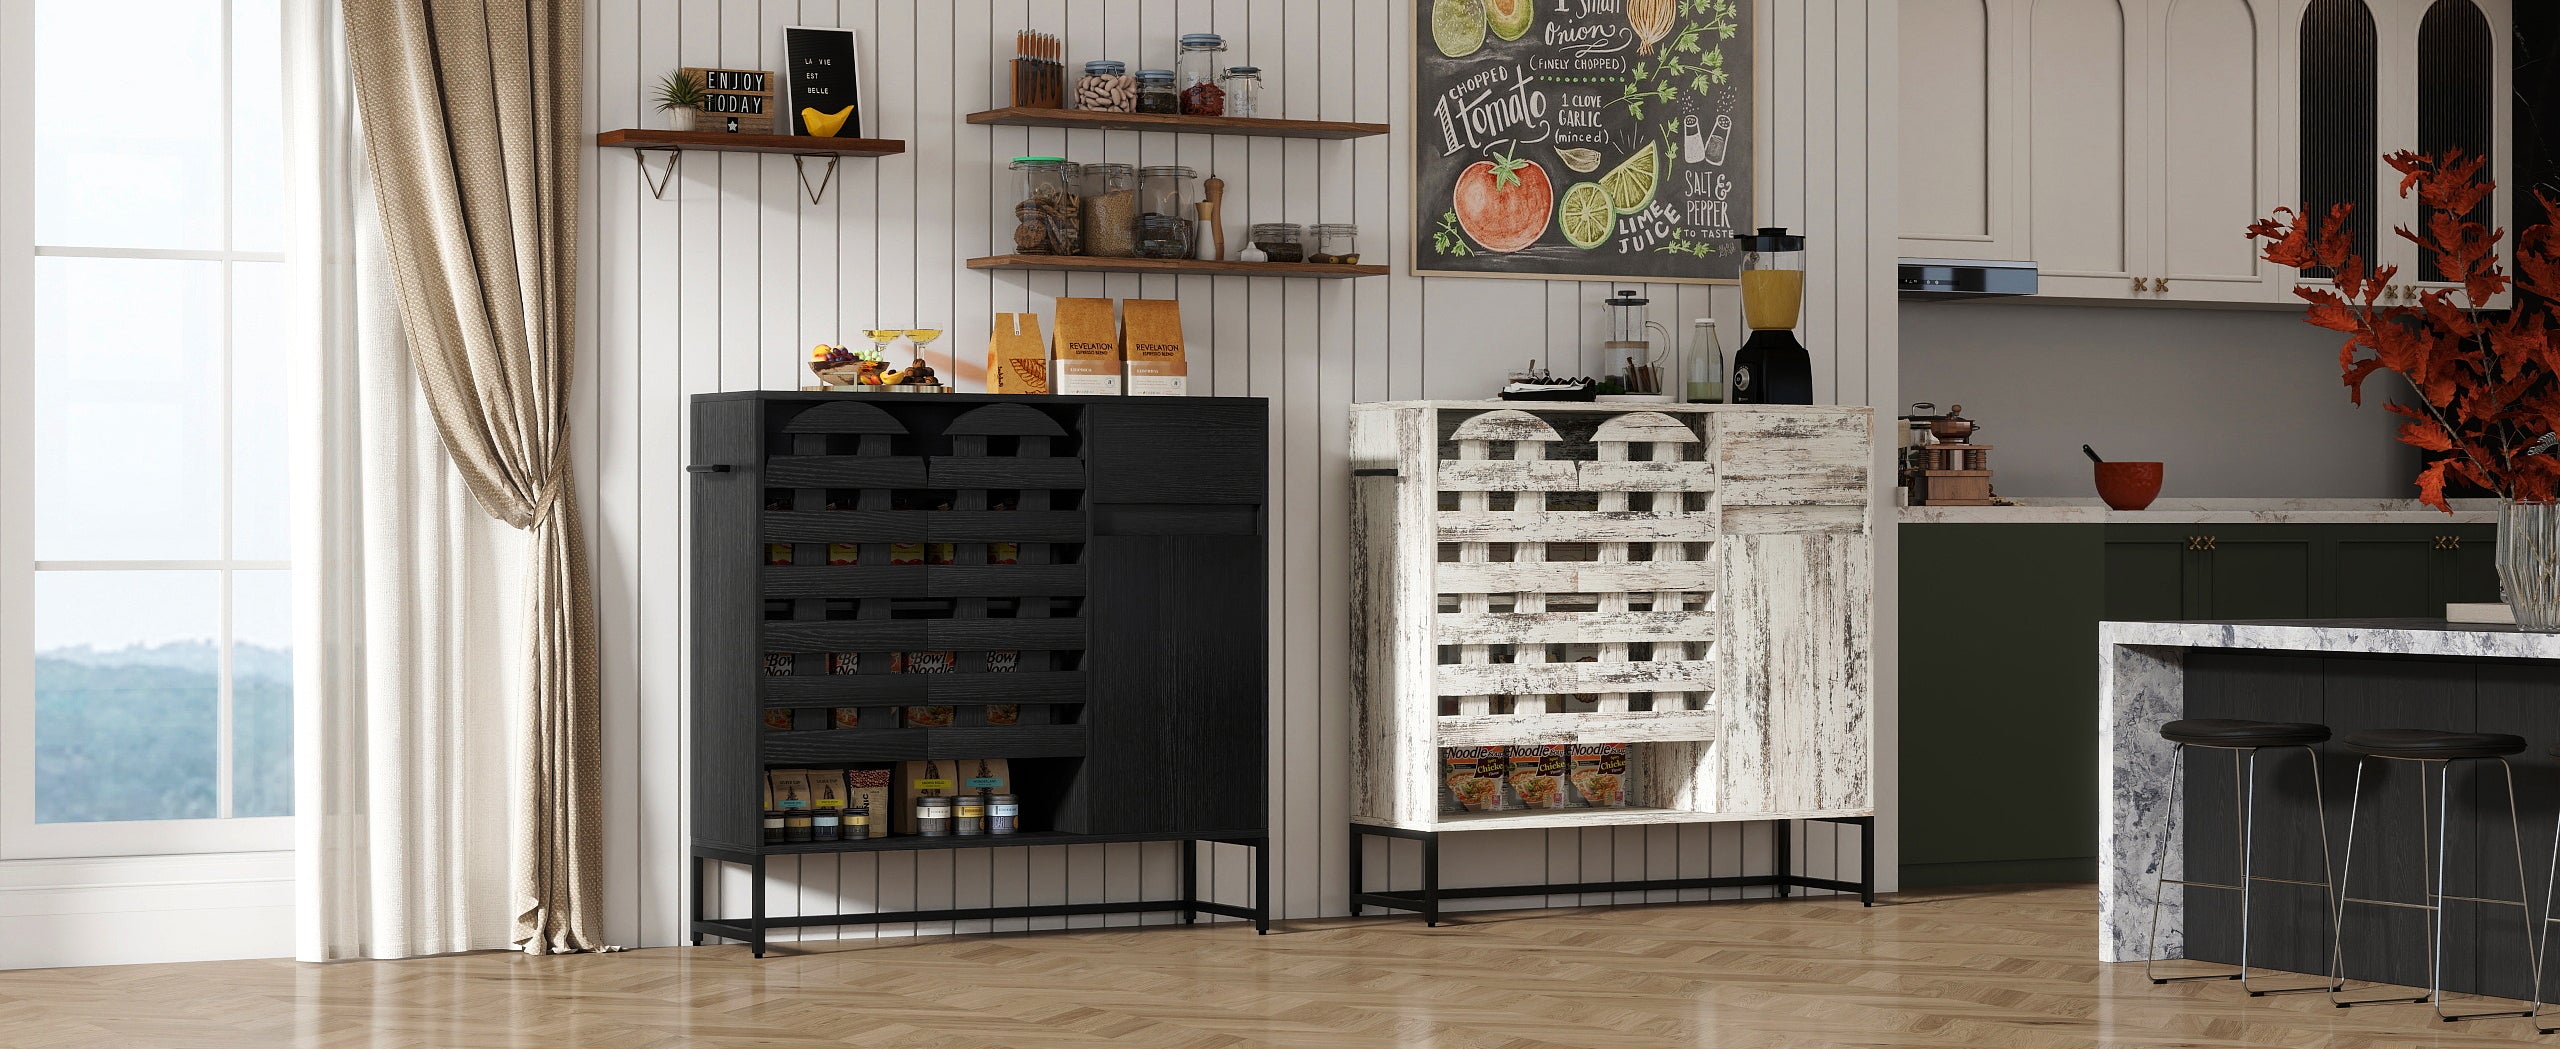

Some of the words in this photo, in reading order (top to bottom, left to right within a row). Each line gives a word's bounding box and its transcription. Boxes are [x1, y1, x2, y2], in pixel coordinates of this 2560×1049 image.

[1554, 0, 1570, 12] 1
[1544, 19, 1616, 46] Onion
[1530, 54, 1569, 70] (FINELY
[1574, 55, 1626, 74] CHOPPED)
[708, 72, 763, 91] ENJOY
[1449, 66, 1508, 100] CHOPPED
[706, 94, 761, 114] TODAY
[1434, 94, 1466, 156] 1
[1455, 64, 1547, 150] tomato
[1561, 93, 1569, 107] 1
[1572, 95, 1602, 108] CLOVE
[1558, 110, 1602, 128] GARLIC
[1685, 170, 1712, 198] SALT
[1715, 174, 1732, 200] &
[1620, 199, 1664, 235] LIME
[1687, 201, 1730, 228] PEPPER
[1619, 203, 1681, 254] JUICE
[1684, 229, 1696, 238] TO
[1701, 229, 1734, 238] TASTE
[913, 650, 947, 664] Bowl
